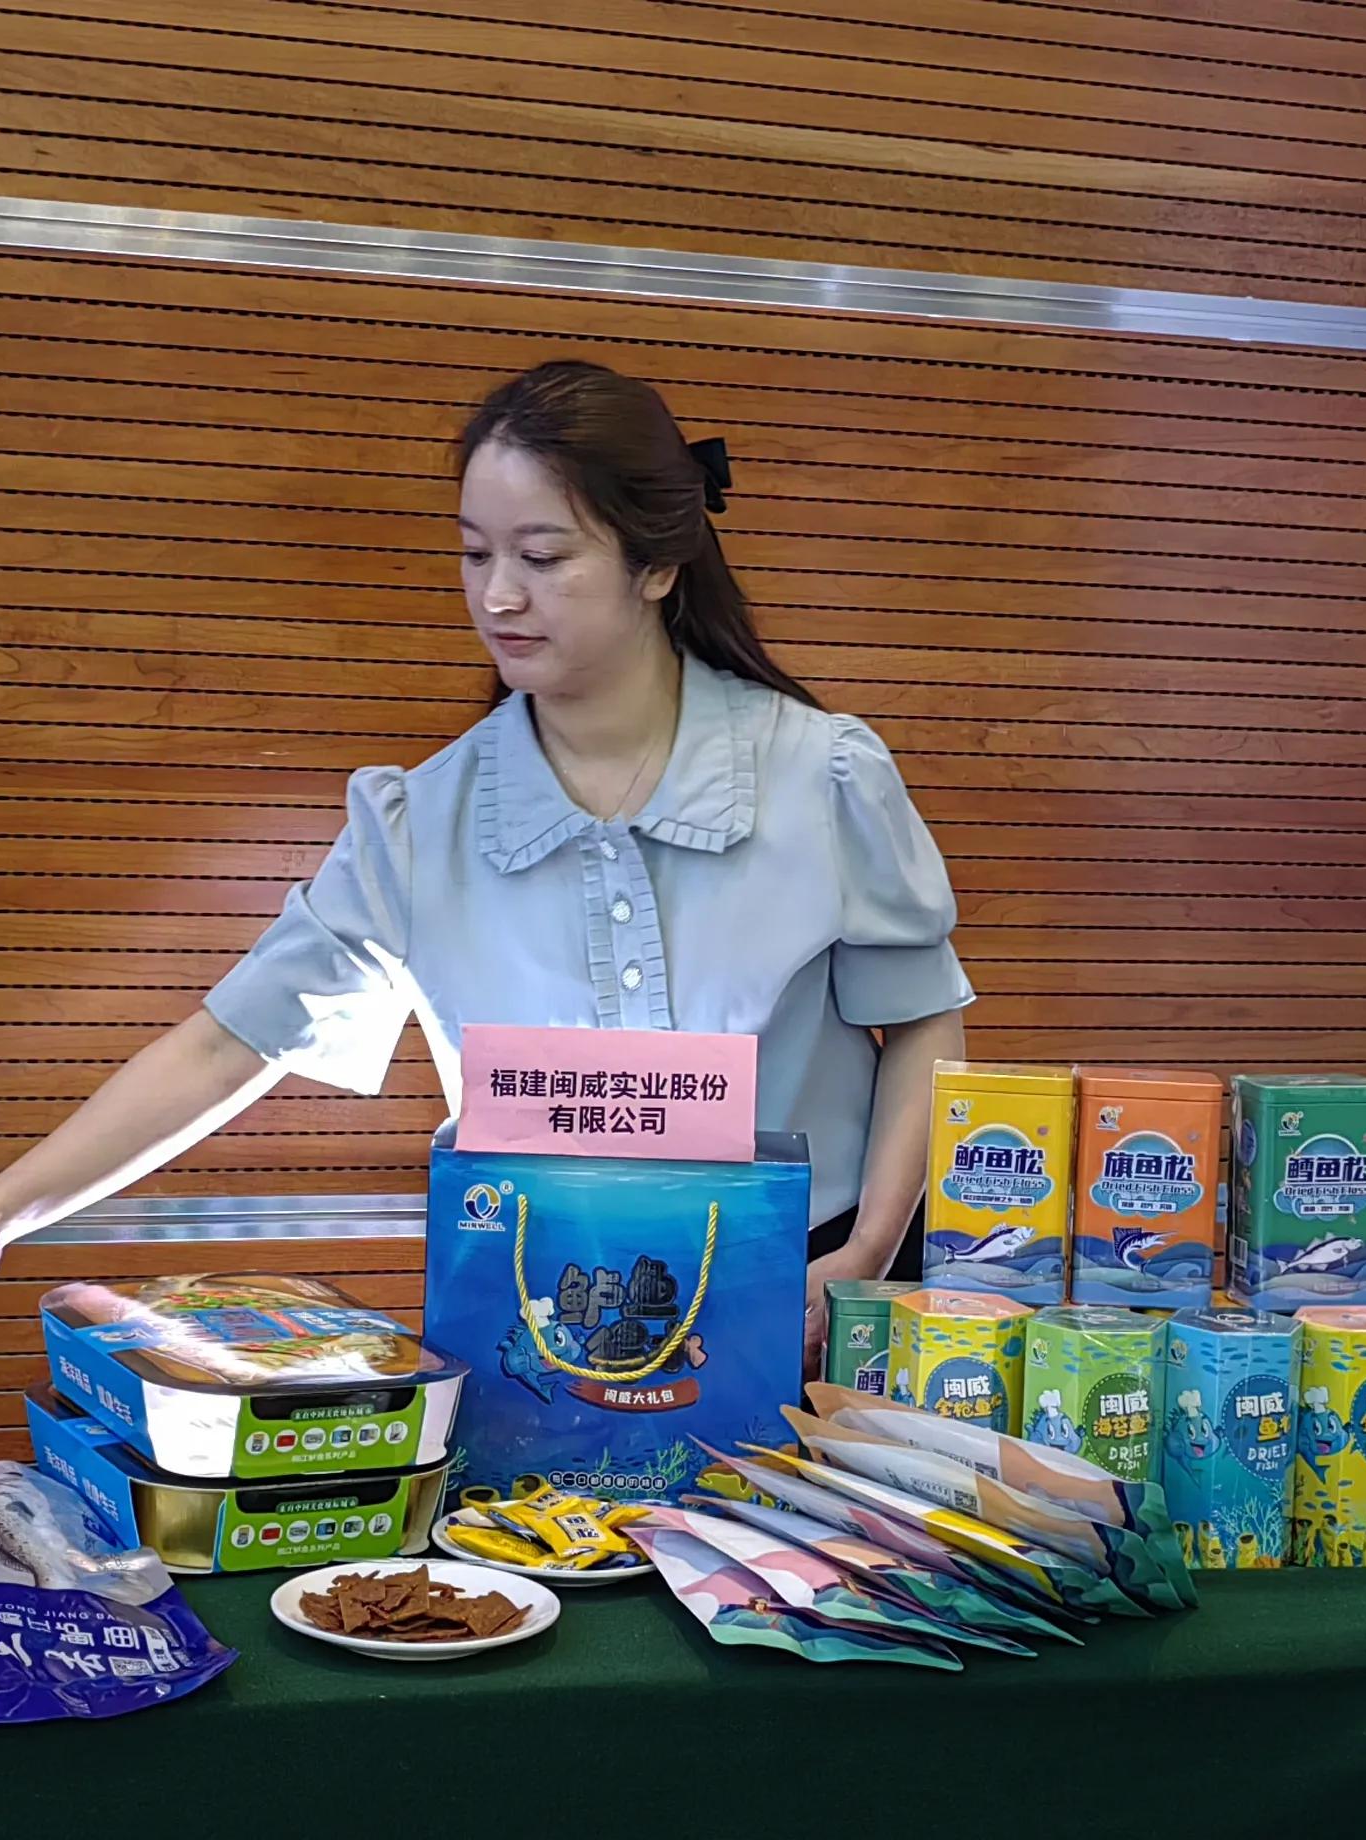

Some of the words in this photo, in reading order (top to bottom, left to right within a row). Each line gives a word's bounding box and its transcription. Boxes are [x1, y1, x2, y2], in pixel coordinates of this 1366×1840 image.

[489, 1067, 730, 1102] 福建闽威实业股份
[548, 1105, 668, 1136] 有限公司
[954, 1143, 1045, 1175] 鲈鱼松
[1103, 1151, 1194, 1182] 旗鱼松
[942, 1375, 992, 1399] 闽威
[1099, 1390, 1150, 1417] 闽威
[1234, 1391, 1286, 1419] 闽威
[43, 1609, 90, 1621] JIANG
